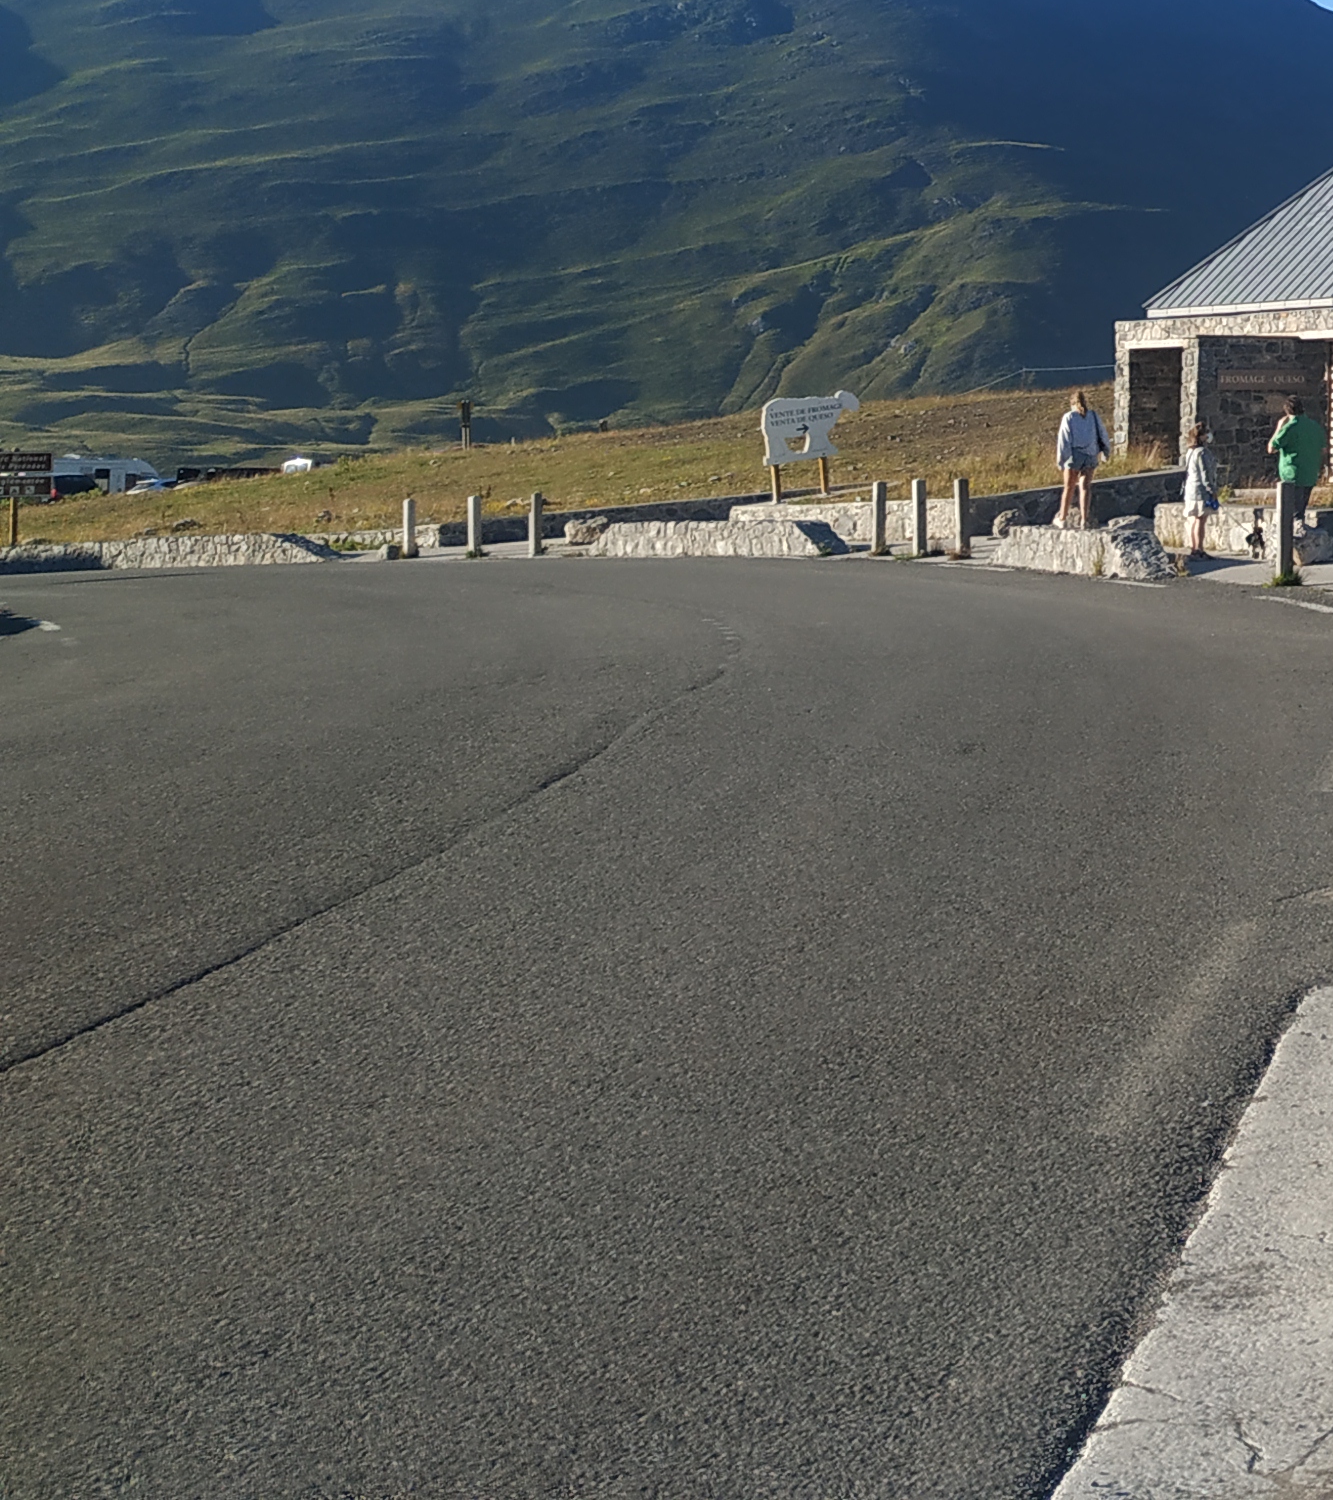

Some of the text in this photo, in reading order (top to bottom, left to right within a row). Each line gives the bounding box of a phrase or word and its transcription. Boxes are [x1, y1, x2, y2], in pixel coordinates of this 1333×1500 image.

[1220, 375, 1267, 384] FROMAGE
[1273, 375, 1305, 385] QUESO
[769, 411, 794, 420] VENTE
[808, 403, 842, 414] FROMAGE
[770, 418, 796, 427] VENTA
[808, 412, 834, 422] QUESO
